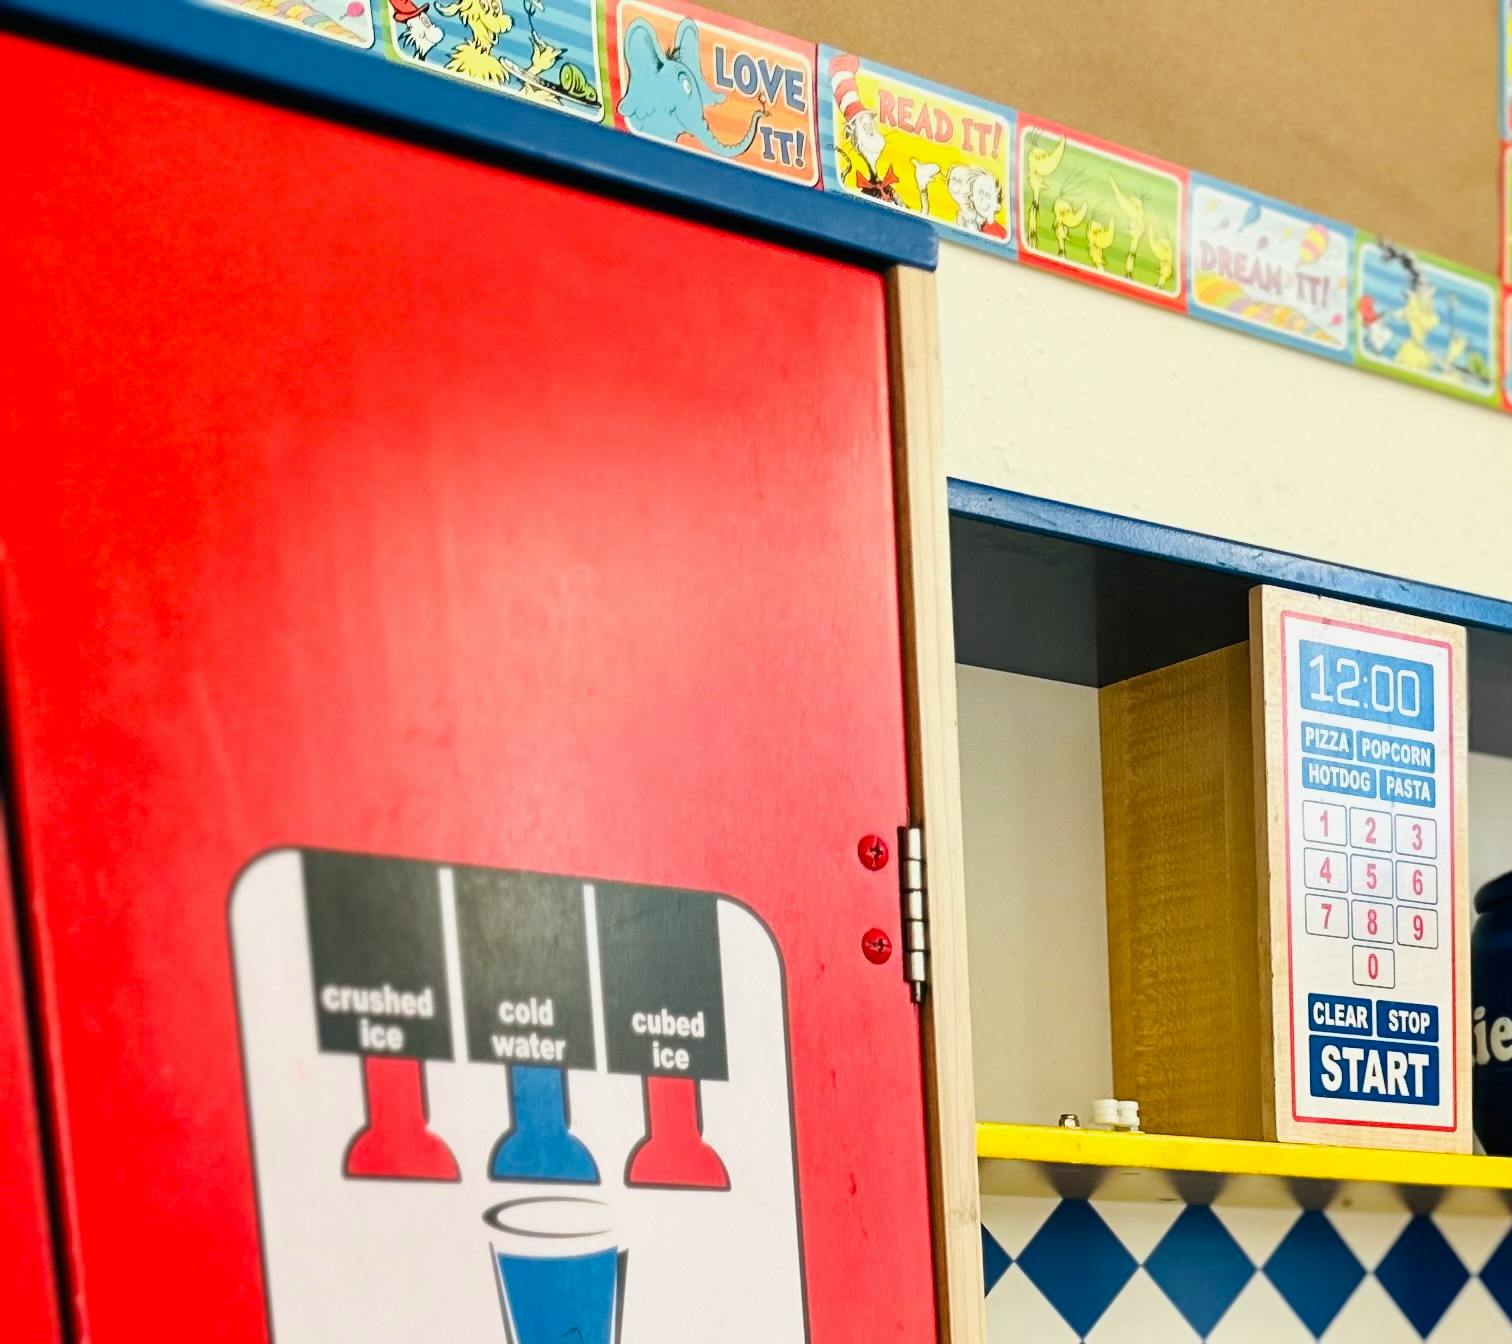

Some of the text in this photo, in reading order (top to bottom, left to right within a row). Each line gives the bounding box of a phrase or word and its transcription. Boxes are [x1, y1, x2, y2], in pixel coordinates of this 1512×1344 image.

[715, 46, 806, 113] LOVE
[877, 87, 1003, 160] READ IT!
[760, 126, 805, 168] IT!
[1199, 239, 1330, 309] DREAM IT!
[1308, 653, 1421, 718] 12:00
[1305, 726, 1432, 768] PIZZA POPCORN
[1308, 762, 1432, 802] HOTDOG PASTA
[1319, 810, 1423, 851] 1 2 3
[1320, 857, 1423, 896] 4 5 6
[1321, 903, 1424, 941] 7 8 9
[1367, 953, 1379, 980] 0
[321, 983, 434, 1017] crushed
[498, 997, 554, 1027] cold
[1312, 1001, 1431, 1034] CLEAR STOP
[360, 1019, 404, 1050] ice
[631, 1008, 705, 1038] cubed
[492, 1033, 566, 1061] water
[652, 1041, 690, 1070] ice
[1320, 1044, 1430, 1098] START
